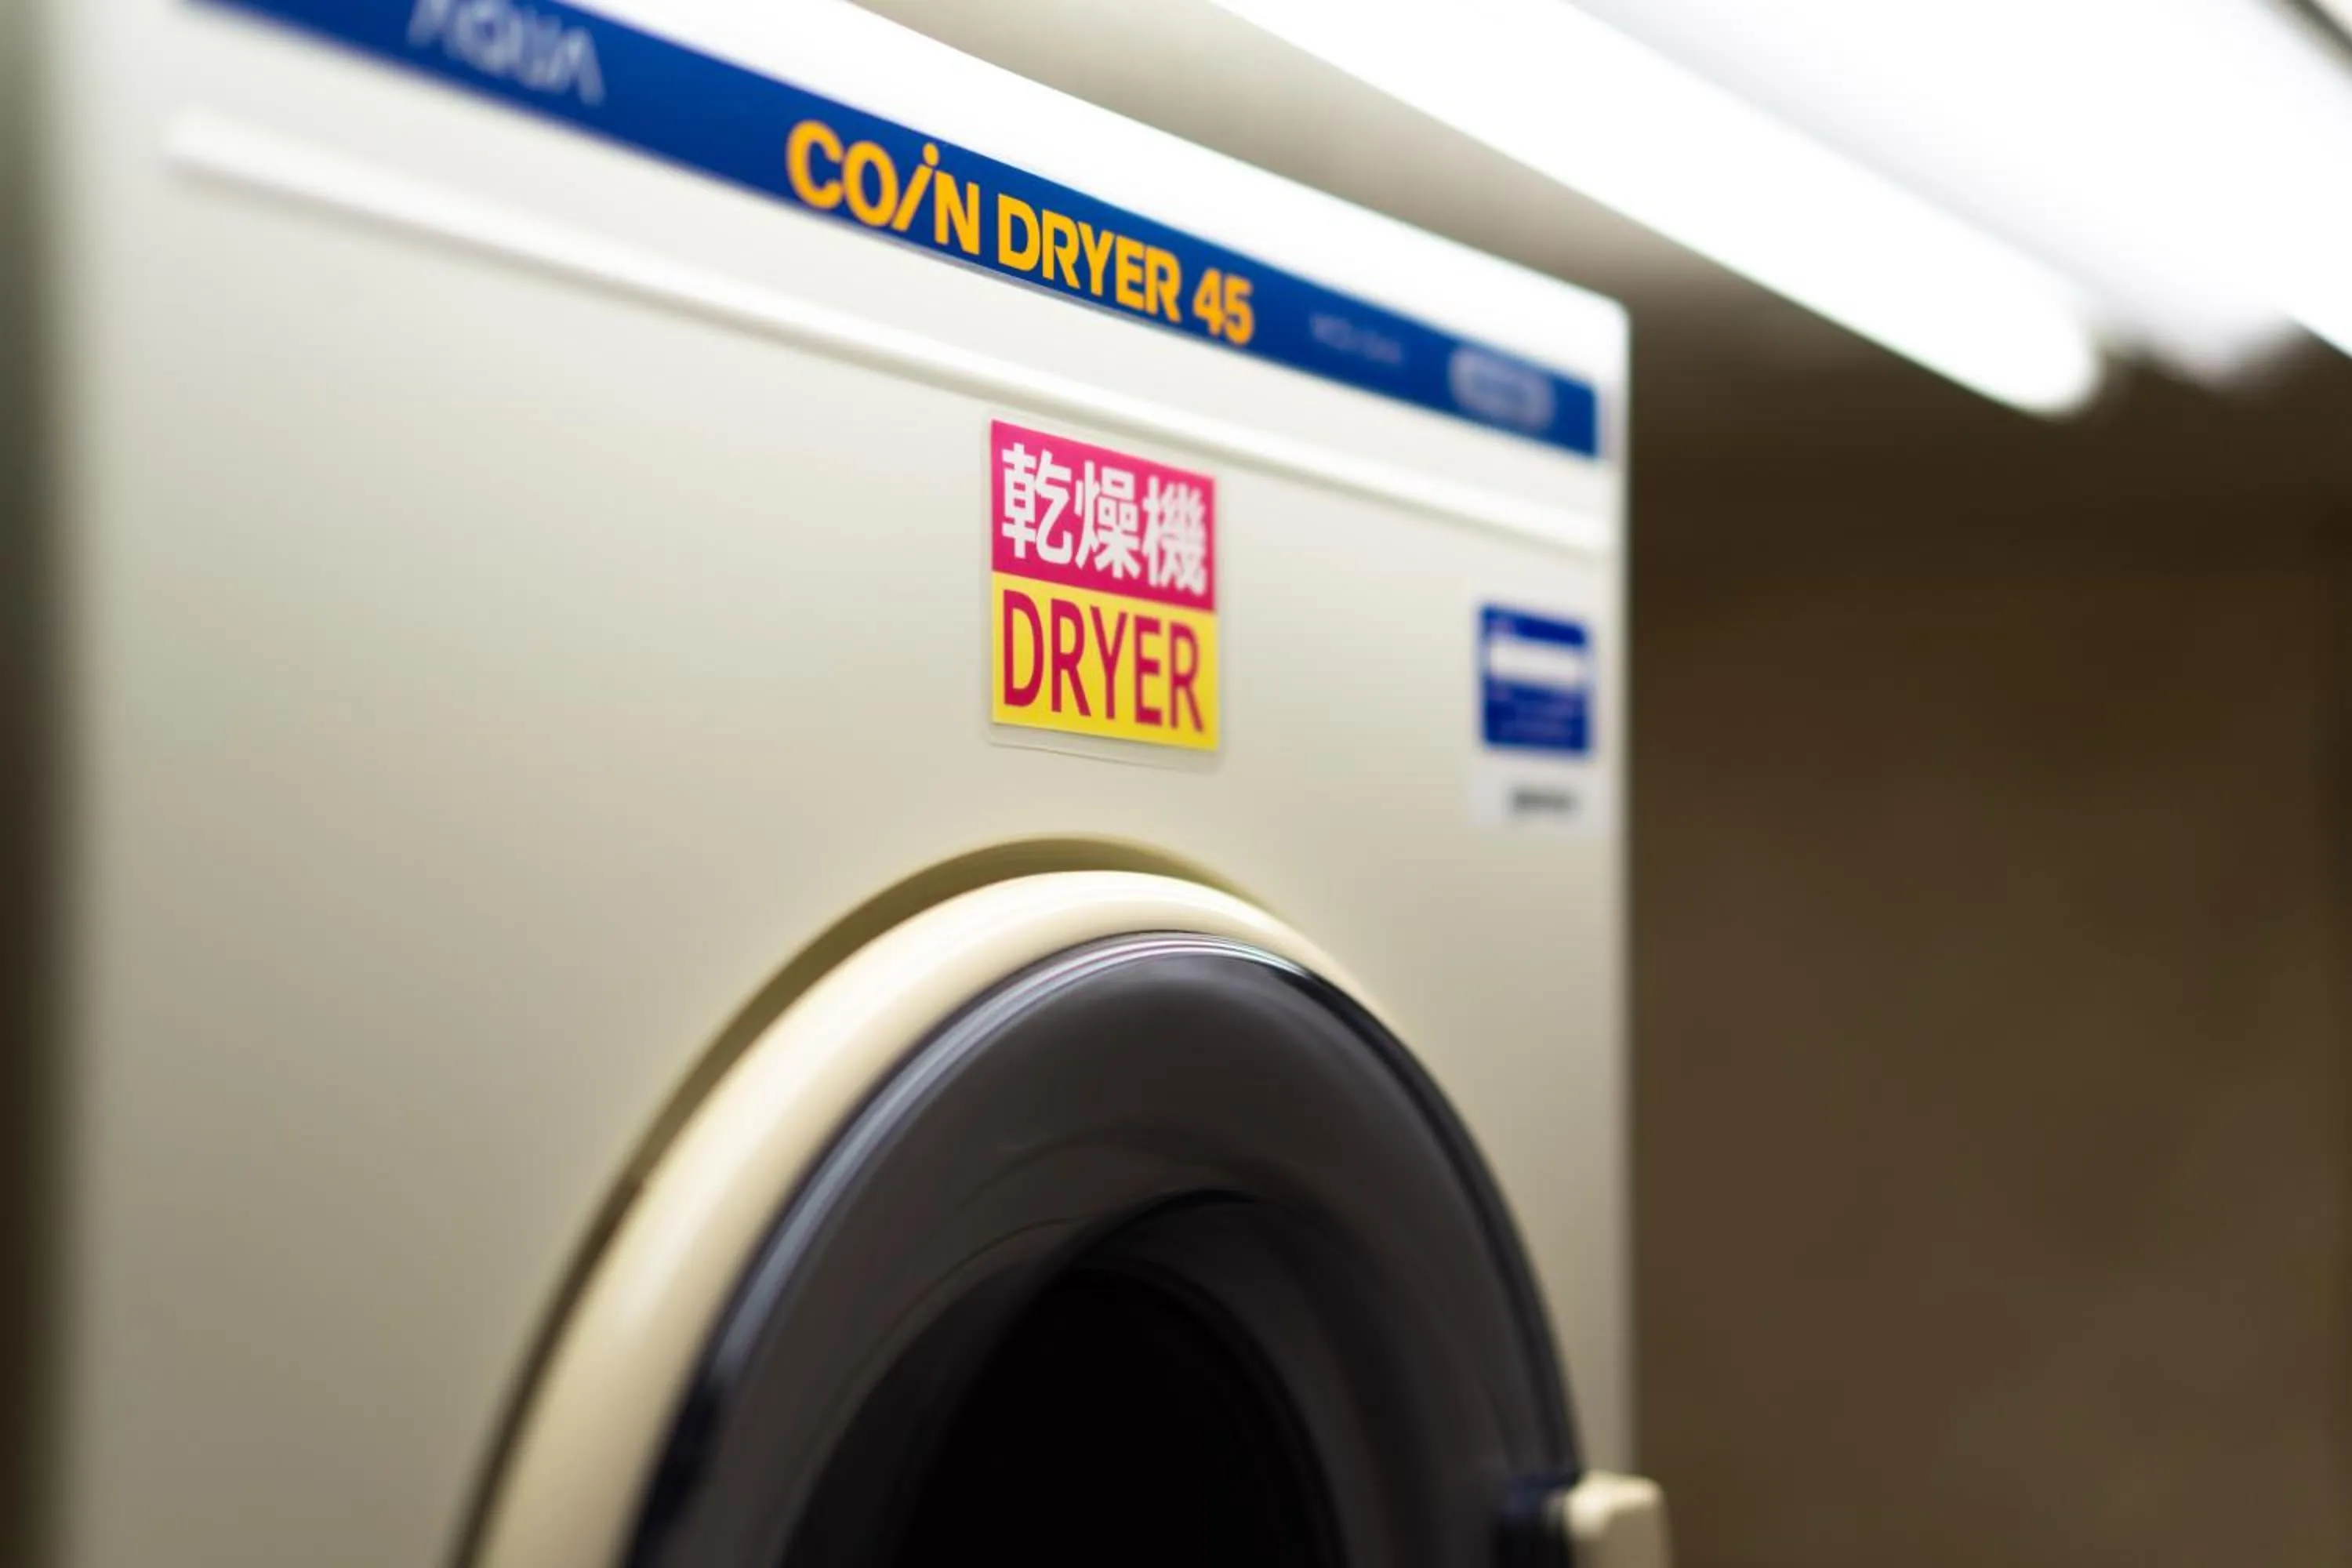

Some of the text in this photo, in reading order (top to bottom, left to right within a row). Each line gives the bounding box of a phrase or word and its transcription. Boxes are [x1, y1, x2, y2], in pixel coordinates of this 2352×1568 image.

[997, 192, 1182, 323] DRYER
[1192, 267, 1254, 345] 45
[1001, 441, 1207, 596] 乾燥機
[1003, 588, 1205, 733] DRYER
